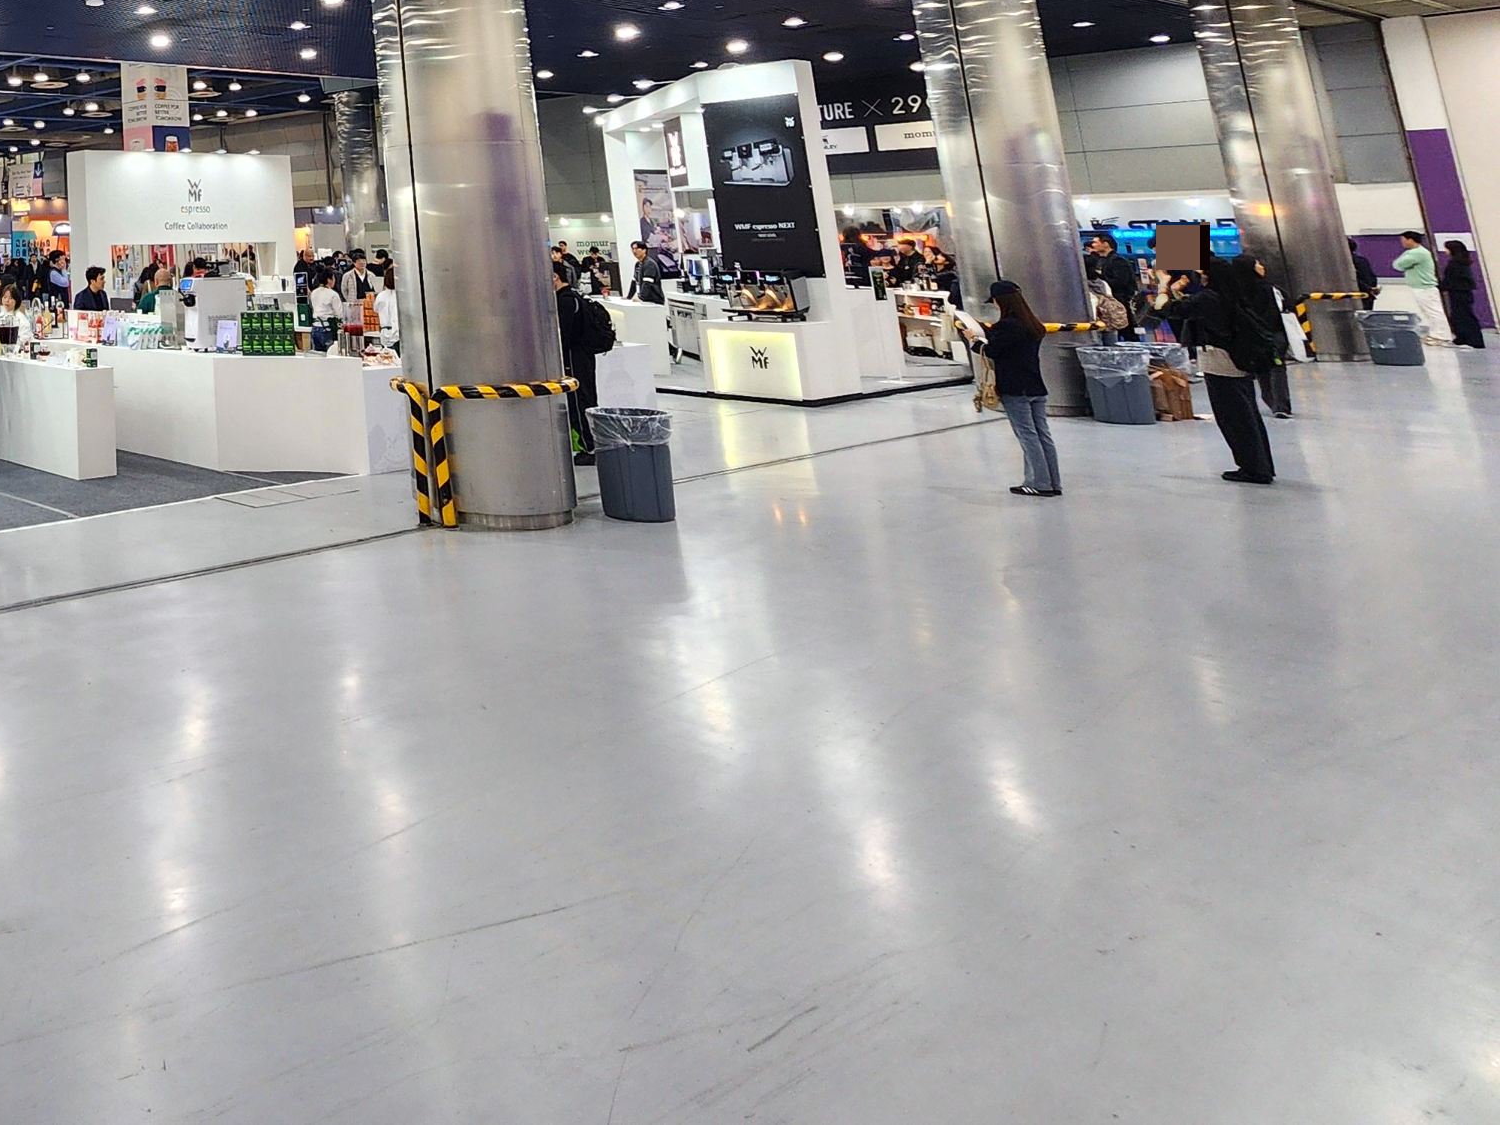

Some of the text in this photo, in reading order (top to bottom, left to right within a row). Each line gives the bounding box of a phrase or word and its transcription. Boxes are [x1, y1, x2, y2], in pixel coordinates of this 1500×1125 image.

[891, 95, 930, 115] 29
[180, 206, 211, 215] espresso
[164, 222, 228, 230] Coffee Collaboration
